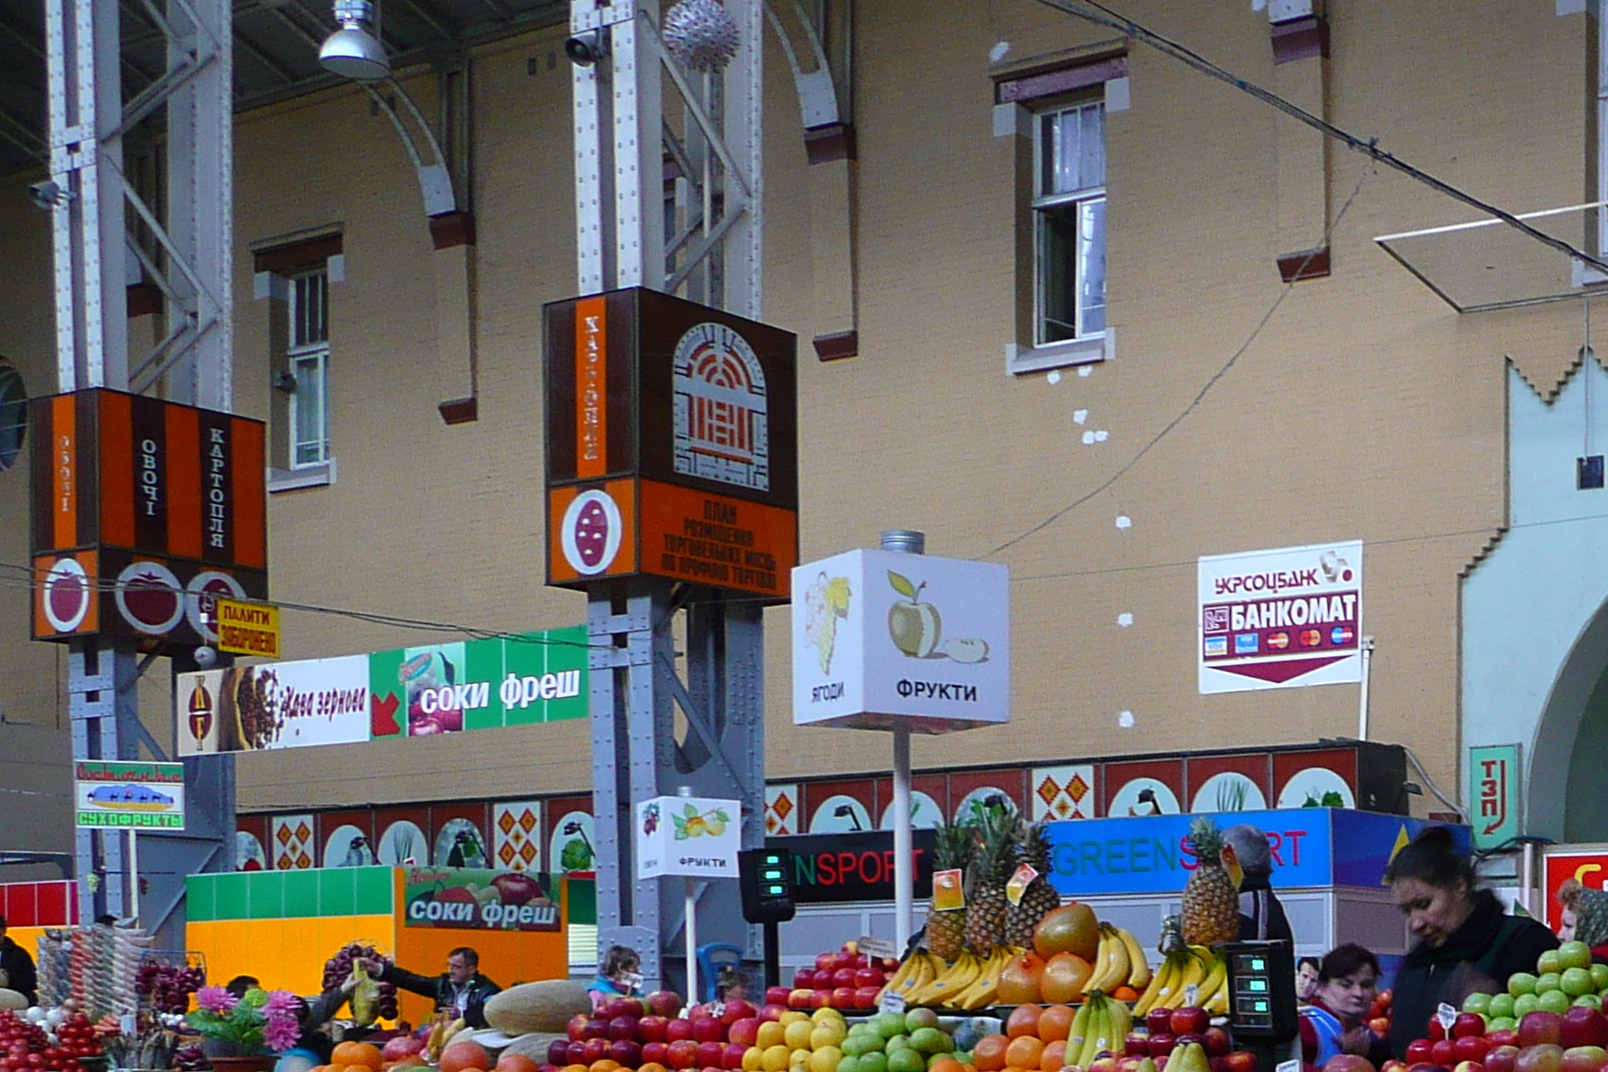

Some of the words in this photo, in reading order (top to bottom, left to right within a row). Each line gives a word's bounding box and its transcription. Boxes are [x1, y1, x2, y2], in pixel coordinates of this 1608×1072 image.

[141, 438, 157, 516] ОВОЧІ
[209, 427, 225, 548] КАРТОПЛЯ
[1214, 568, 1320, 596] УКРСОЦБАНК
[223, 605, 270, 626] ПАЛИТИ
[1231, 594, 1357, 631] БАНКОМАТ
[419, 681, 491, 714] соки
[499, 669, 581, 710] фреш
[811, 681, 846, 703] ЯГОДИ
[896, 678, 978, 702] ФРУКТИ
[1480, 759, 1498, 818] ТЗП
[77, 811, 184, 827] СУХОФРУКТЫ
[678, 856, 728, 869] ФРУКТИ
[1052, 830, 1308, 877] GREENSRT
[409, 900, 474, 921] соки
[481, 899, 556, 928] фреш
